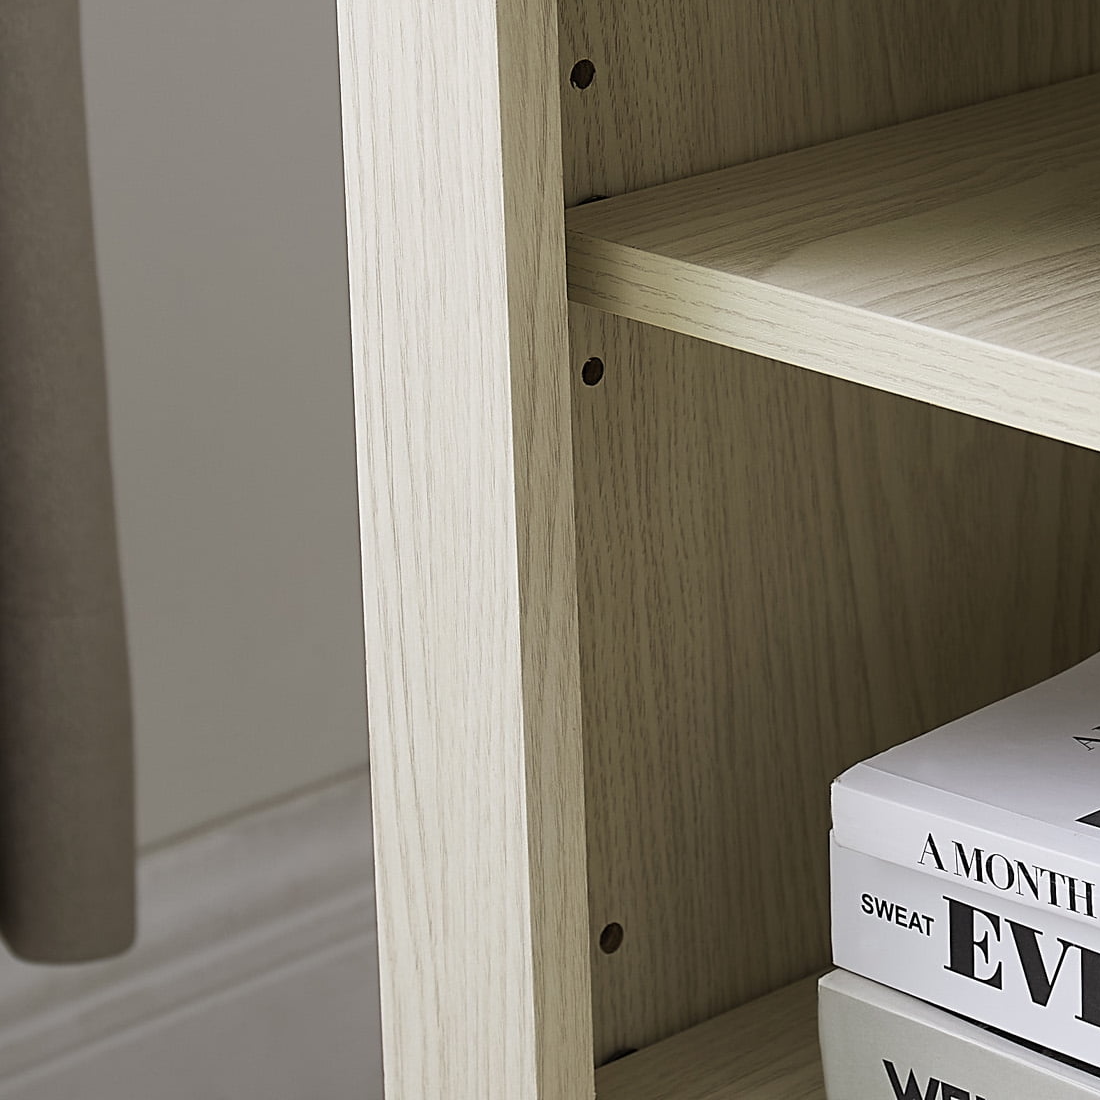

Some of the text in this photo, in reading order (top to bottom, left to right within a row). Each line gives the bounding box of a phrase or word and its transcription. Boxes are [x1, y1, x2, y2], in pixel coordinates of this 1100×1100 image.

[917, 833, 948, 873] A
[952, 840, 1096, 919] MONTH
[861, 893, 934, 936] SWEAT
